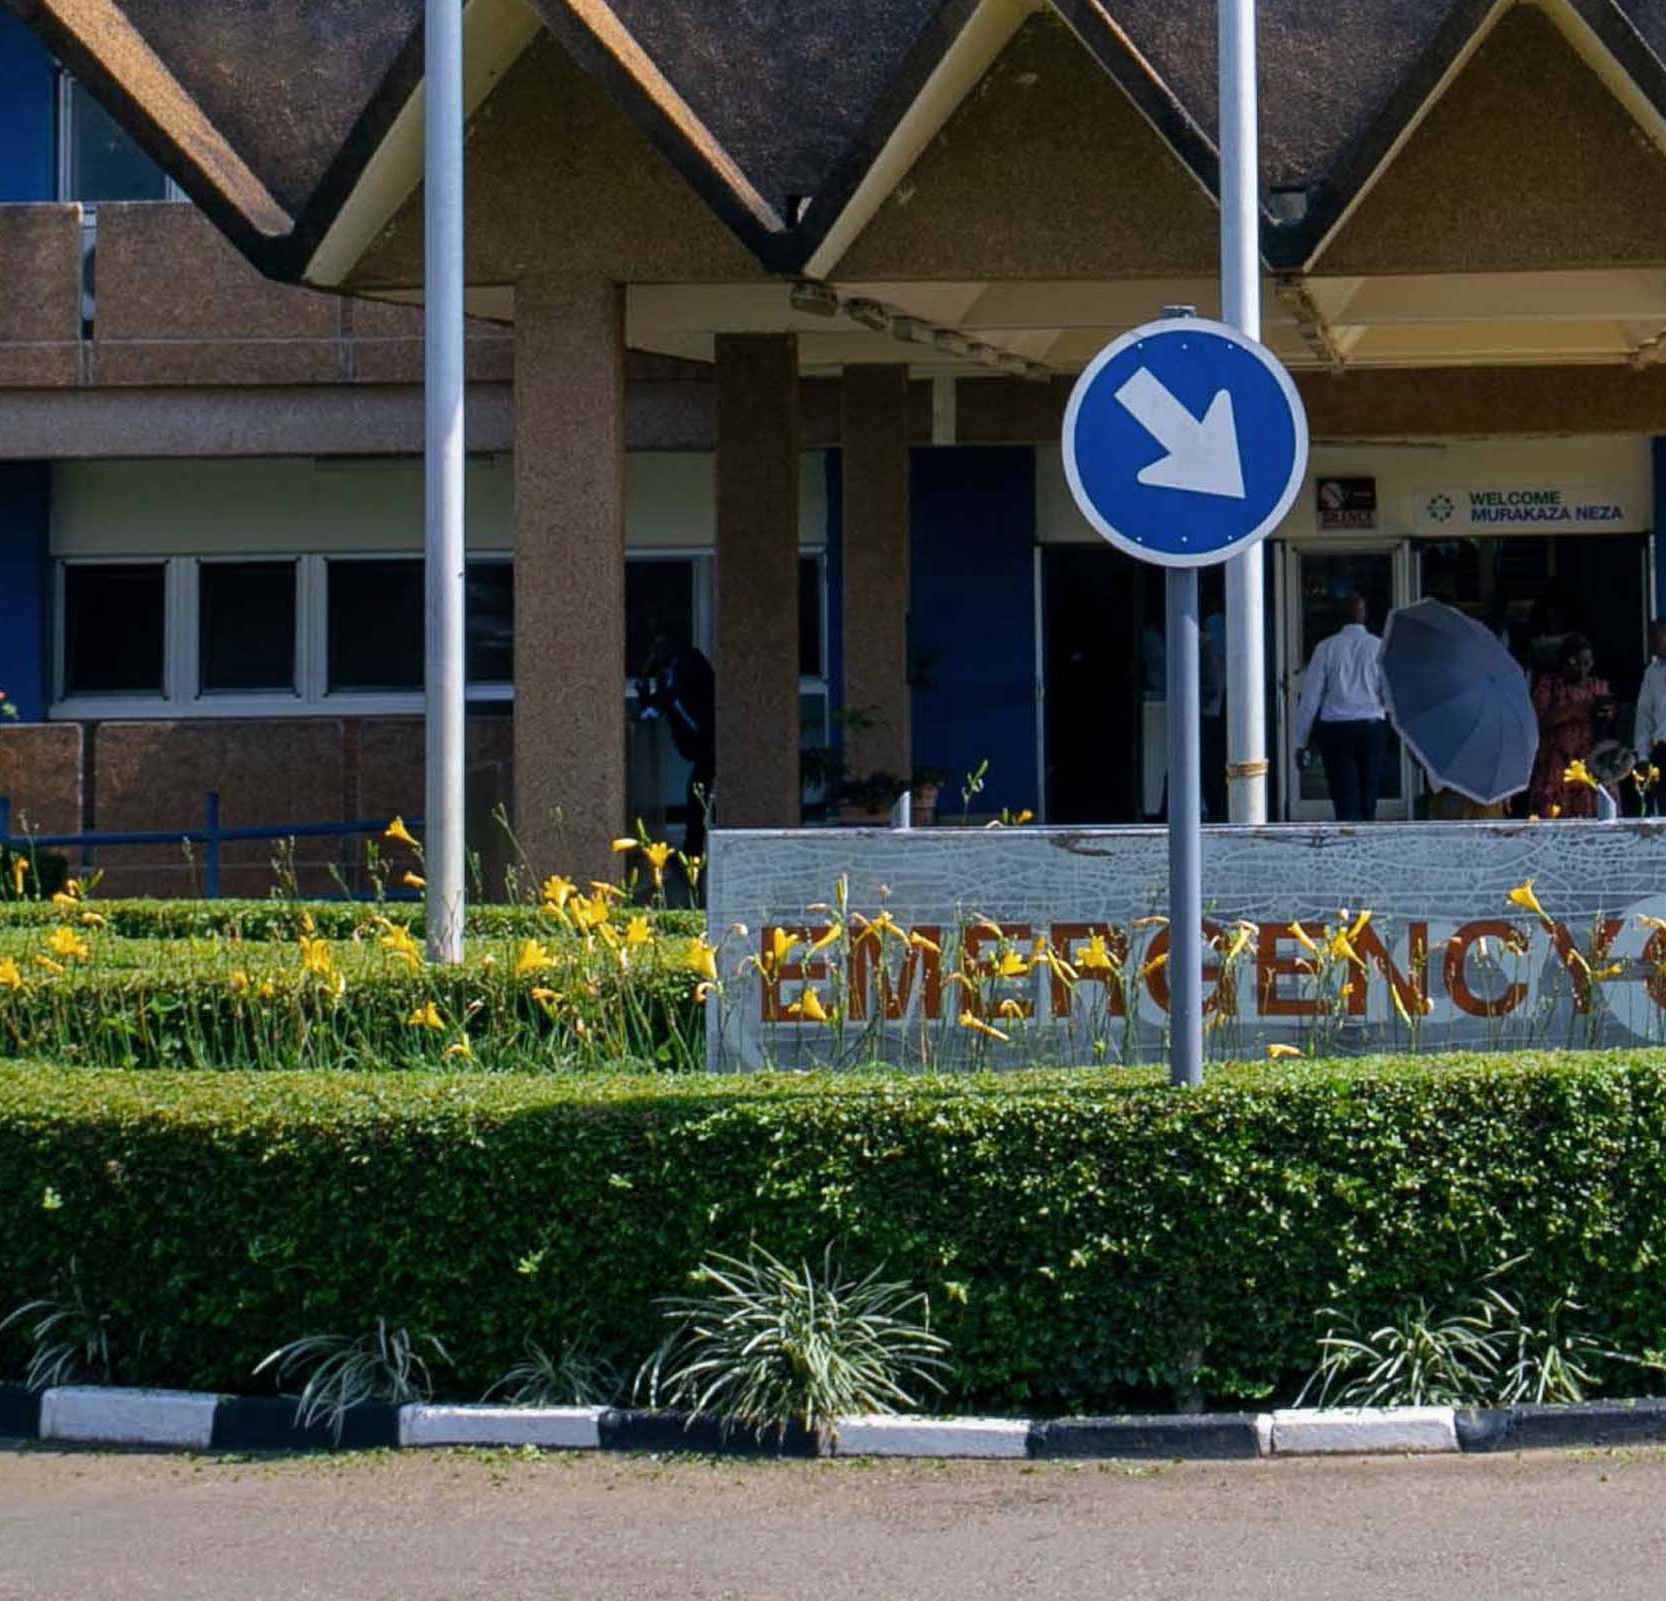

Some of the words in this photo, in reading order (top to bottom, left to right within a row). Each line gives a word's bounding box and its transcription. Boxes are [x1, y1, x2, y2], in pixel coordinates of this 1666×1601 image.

[1469, 491, 1561, 506] WELCOME
[1471, 506, 1572, 522] MURAKAZA
[1576, 505, 1624, 521] NEZA
[760, 918, 1625, 1022] EMERGENCY
